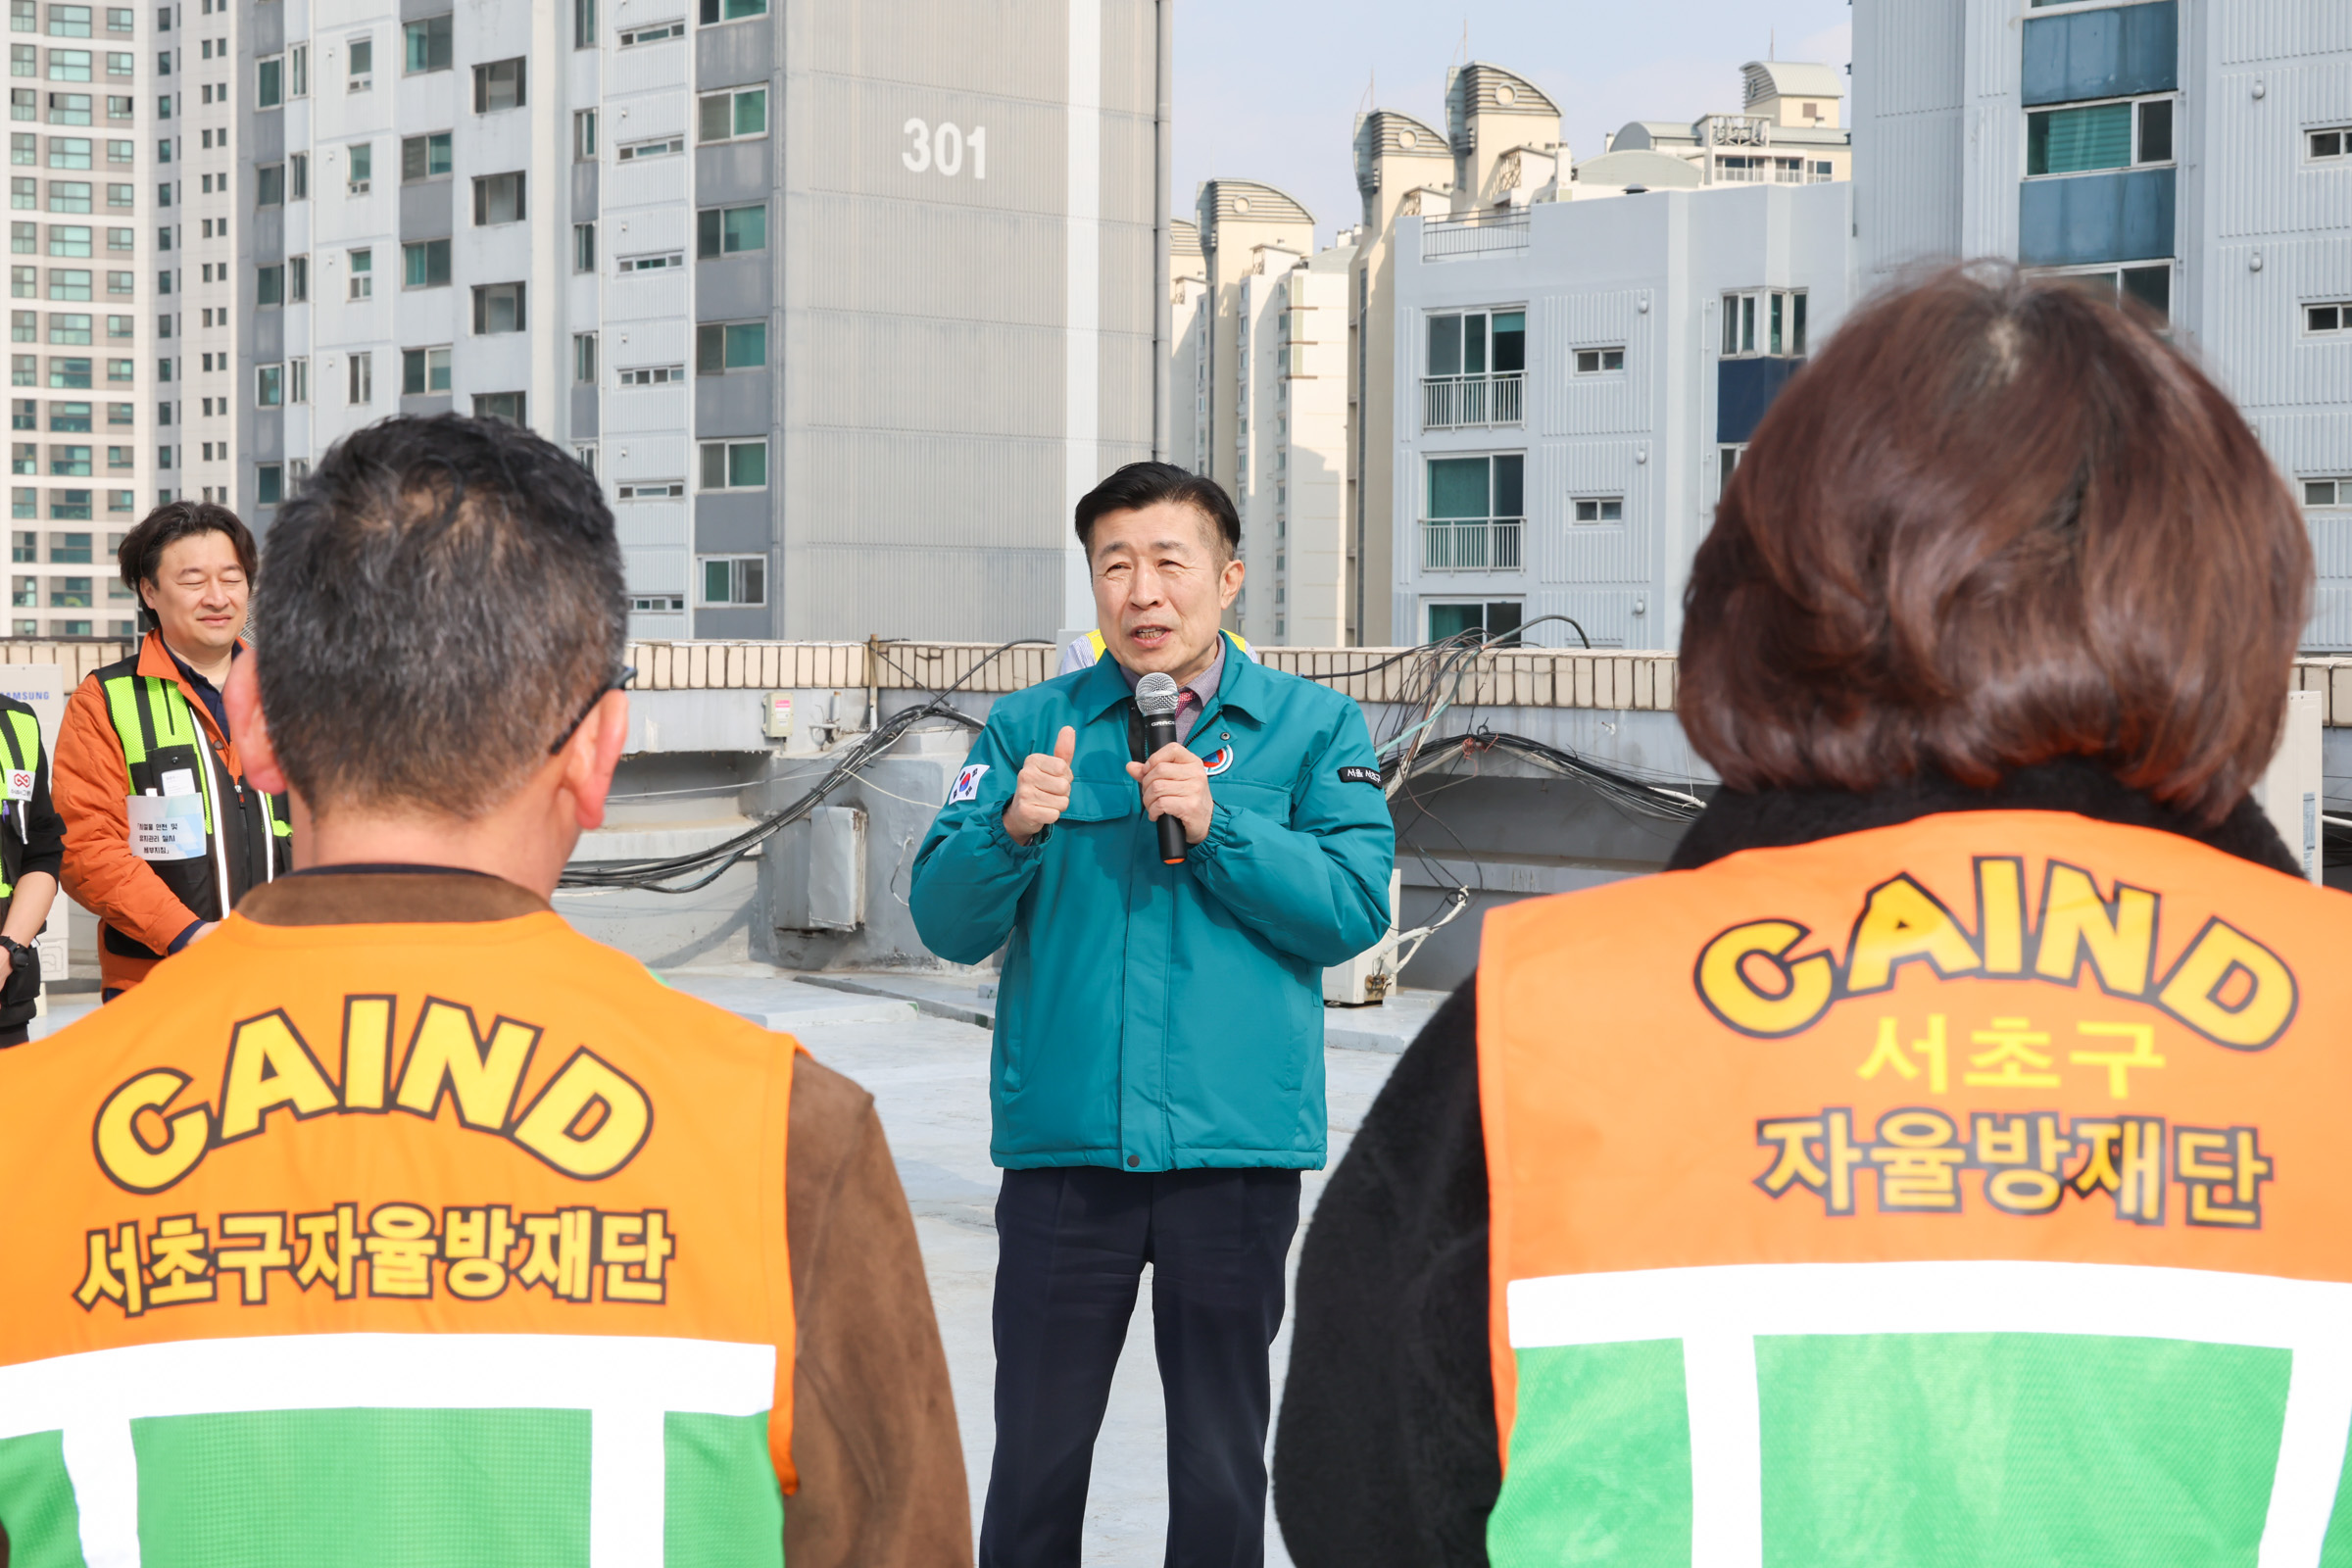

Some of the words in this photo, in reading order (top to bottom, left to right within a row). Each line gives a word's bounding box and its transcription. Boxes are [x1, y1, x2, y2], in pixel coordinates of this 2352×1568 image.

[902, 118, 986, 179] 301
[0, 691, 50, 700] AMSUNG
[1347, 768, 1364, 778] 서울
[1364, 769, 1382, 783] 서초구
[1693, 856, 2299, 1053] CAIND
[92, 994, 654, 1196] CAIND
[1857, 1013, 2166, 1100] 서초구
[1752, 1105, 2274, 1230] 자율방재단
[73, 1201, 675, 1317] 서초구자율방재단
